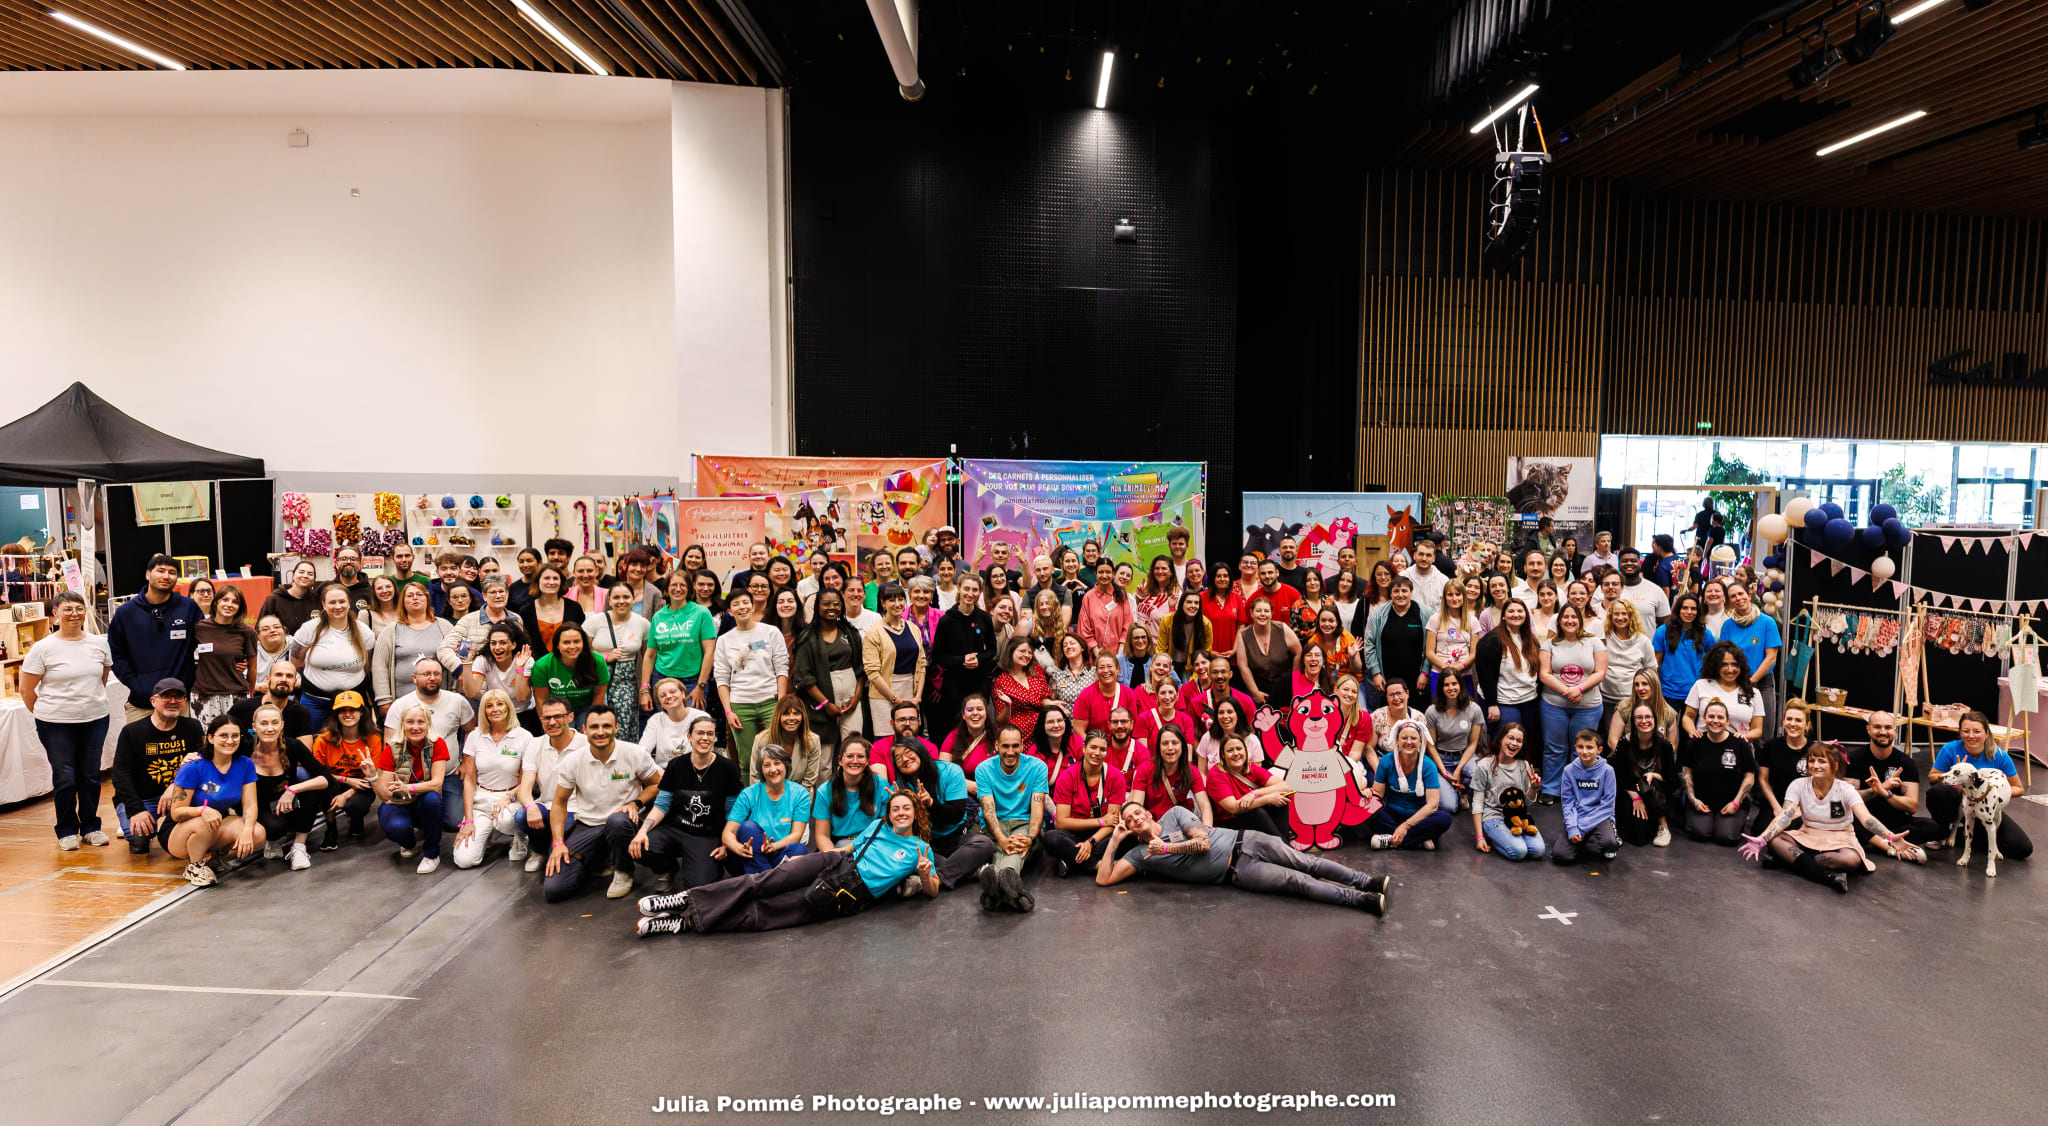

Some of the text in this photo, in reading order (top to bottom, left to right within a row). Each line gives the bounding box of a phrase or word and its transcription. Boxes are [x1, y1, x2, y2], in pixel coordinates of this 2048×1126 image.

[988, 472, 1002, 481] DES
[1003, 472, 1033, 481] CARNETS
[1041, 474, 1095, 482] PERSONNALISER
[985, 482, 1099, 492] POUR VOS PLUS BEAUX SOUVENIRS
[1123, 483, 1146, 493] ANIMAL
[712, 531, 748, 539] ILLUSTRER
[669, 620, 695, 632] AVF
